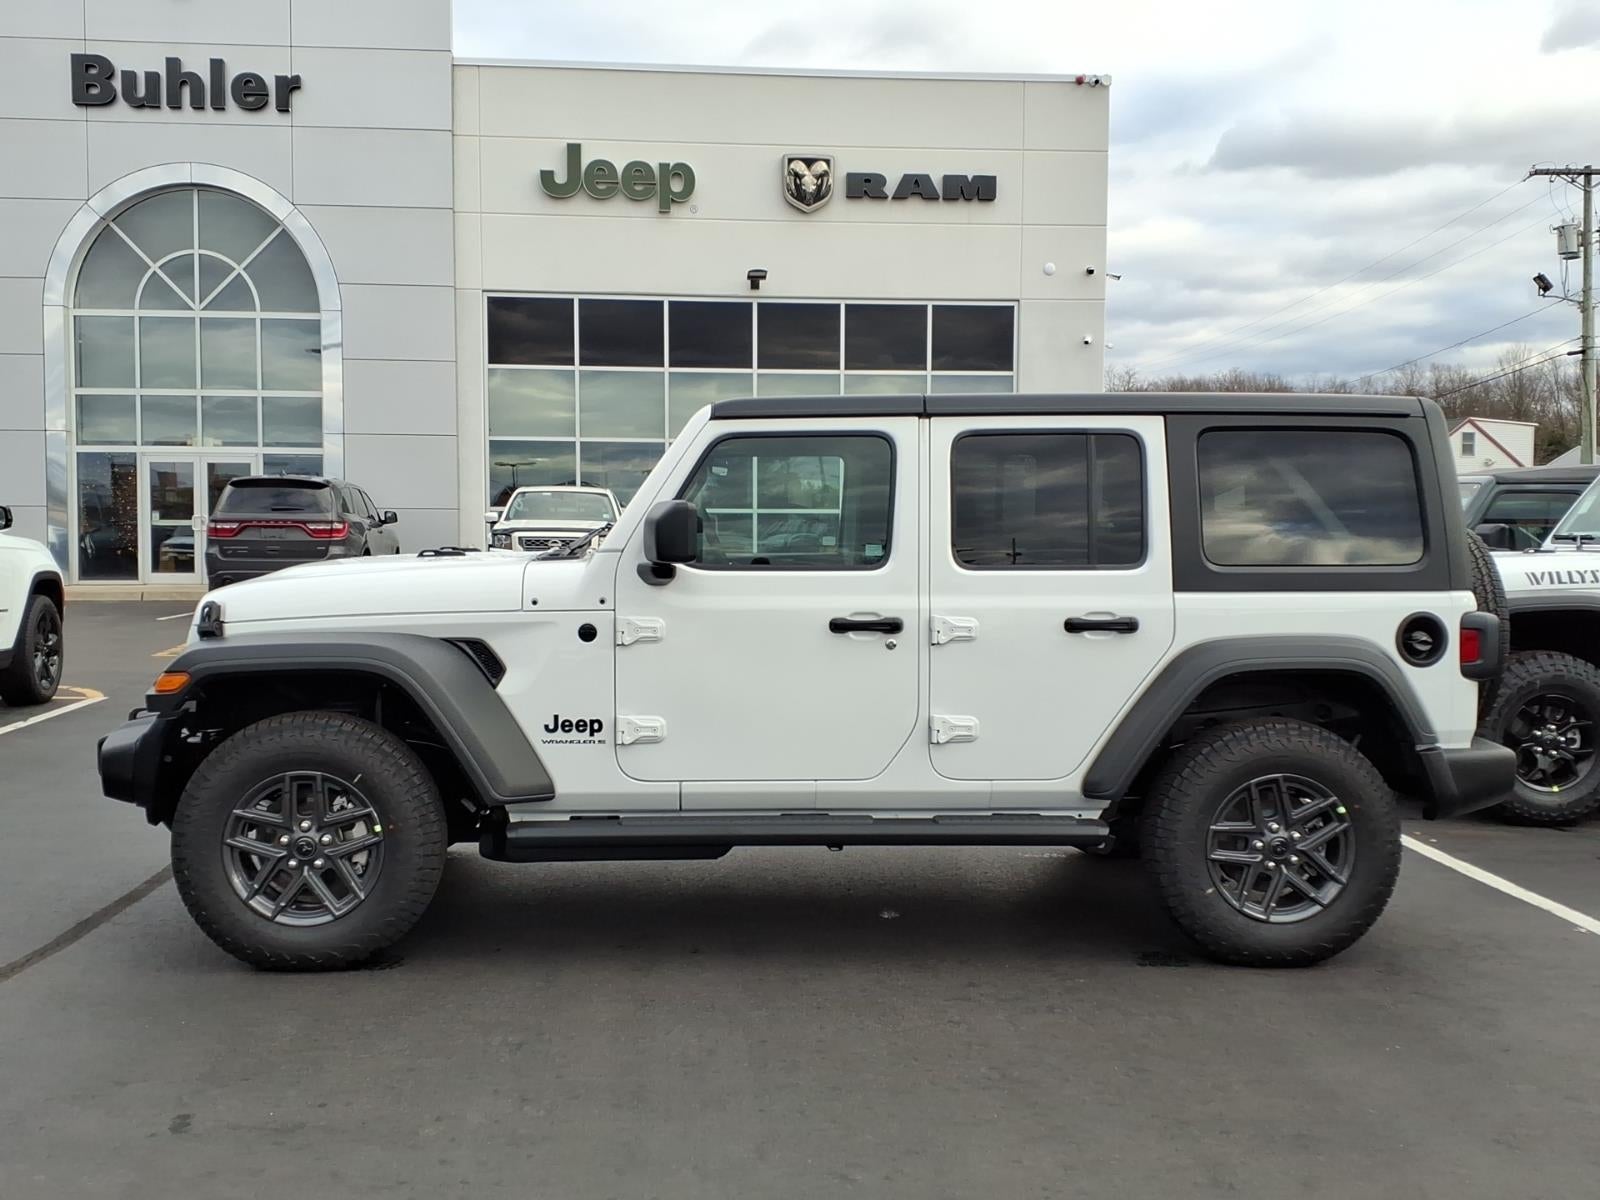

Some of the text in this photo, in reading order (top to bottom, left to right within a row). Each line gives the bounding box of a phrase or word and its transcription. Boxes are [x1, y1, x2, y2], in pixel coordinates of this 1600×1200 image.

[70, 53, 302, 112] Buhler
[540, 143, 696, 213] Jeep
[846, 172, 997, 201] RAM
[1524, 569, 1600, 585] WILLYS
[544, 714, 604, 737] Jeep
